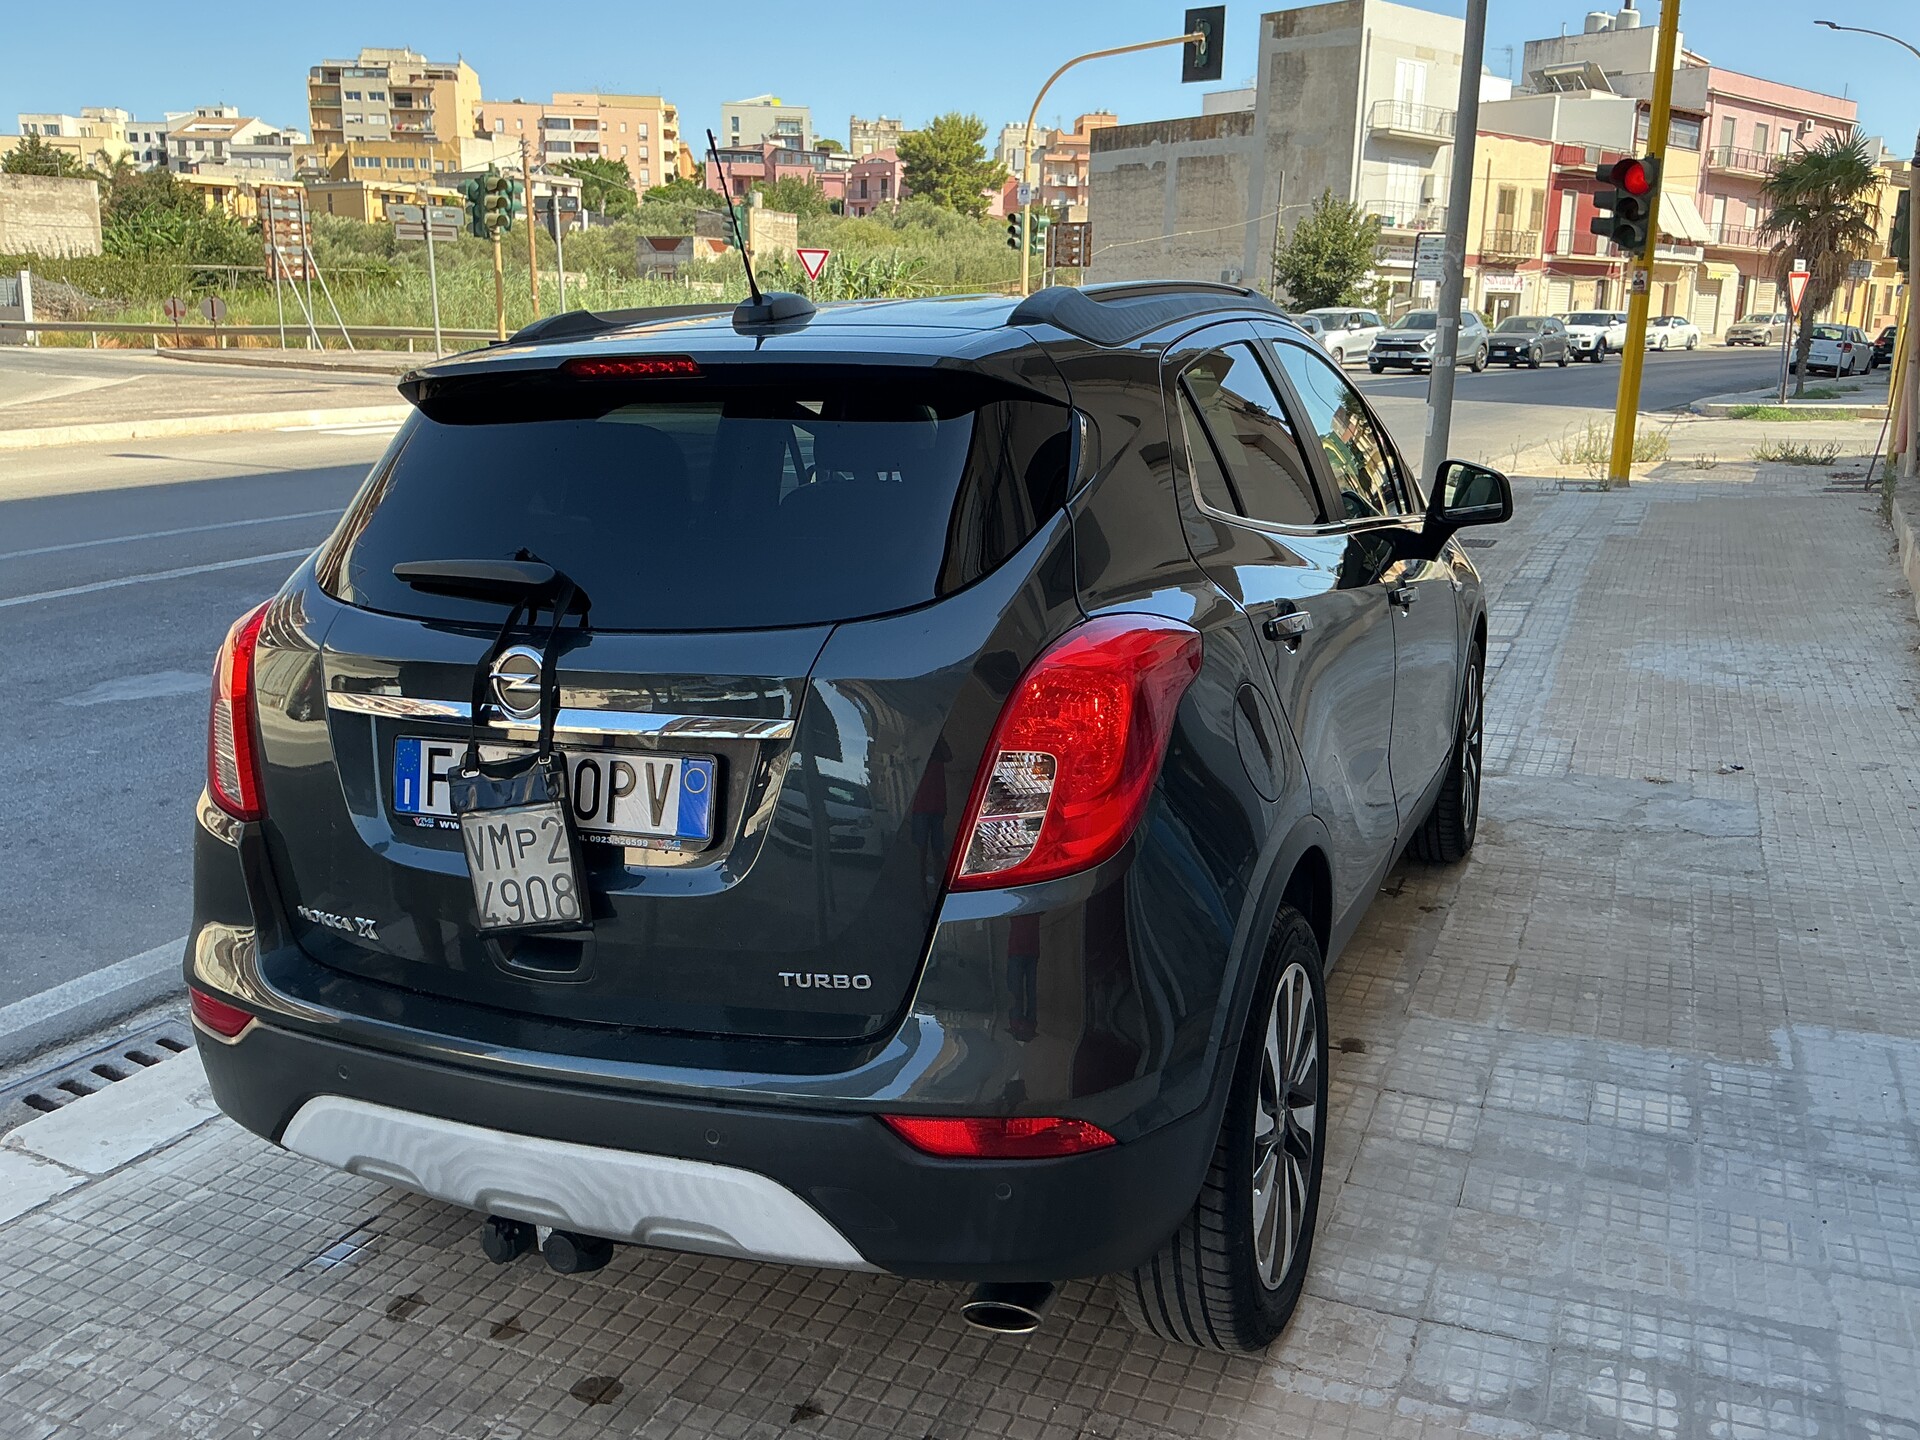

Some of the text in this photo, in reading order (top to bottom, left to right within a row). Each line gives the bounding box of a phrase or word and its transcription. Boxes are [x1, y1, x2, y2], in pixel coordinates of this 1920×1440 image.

[483, 872, 577, 927] 4908
[297, 905, 380, 940] MOKKA X
[778, 971, 872, 990] TURBO
